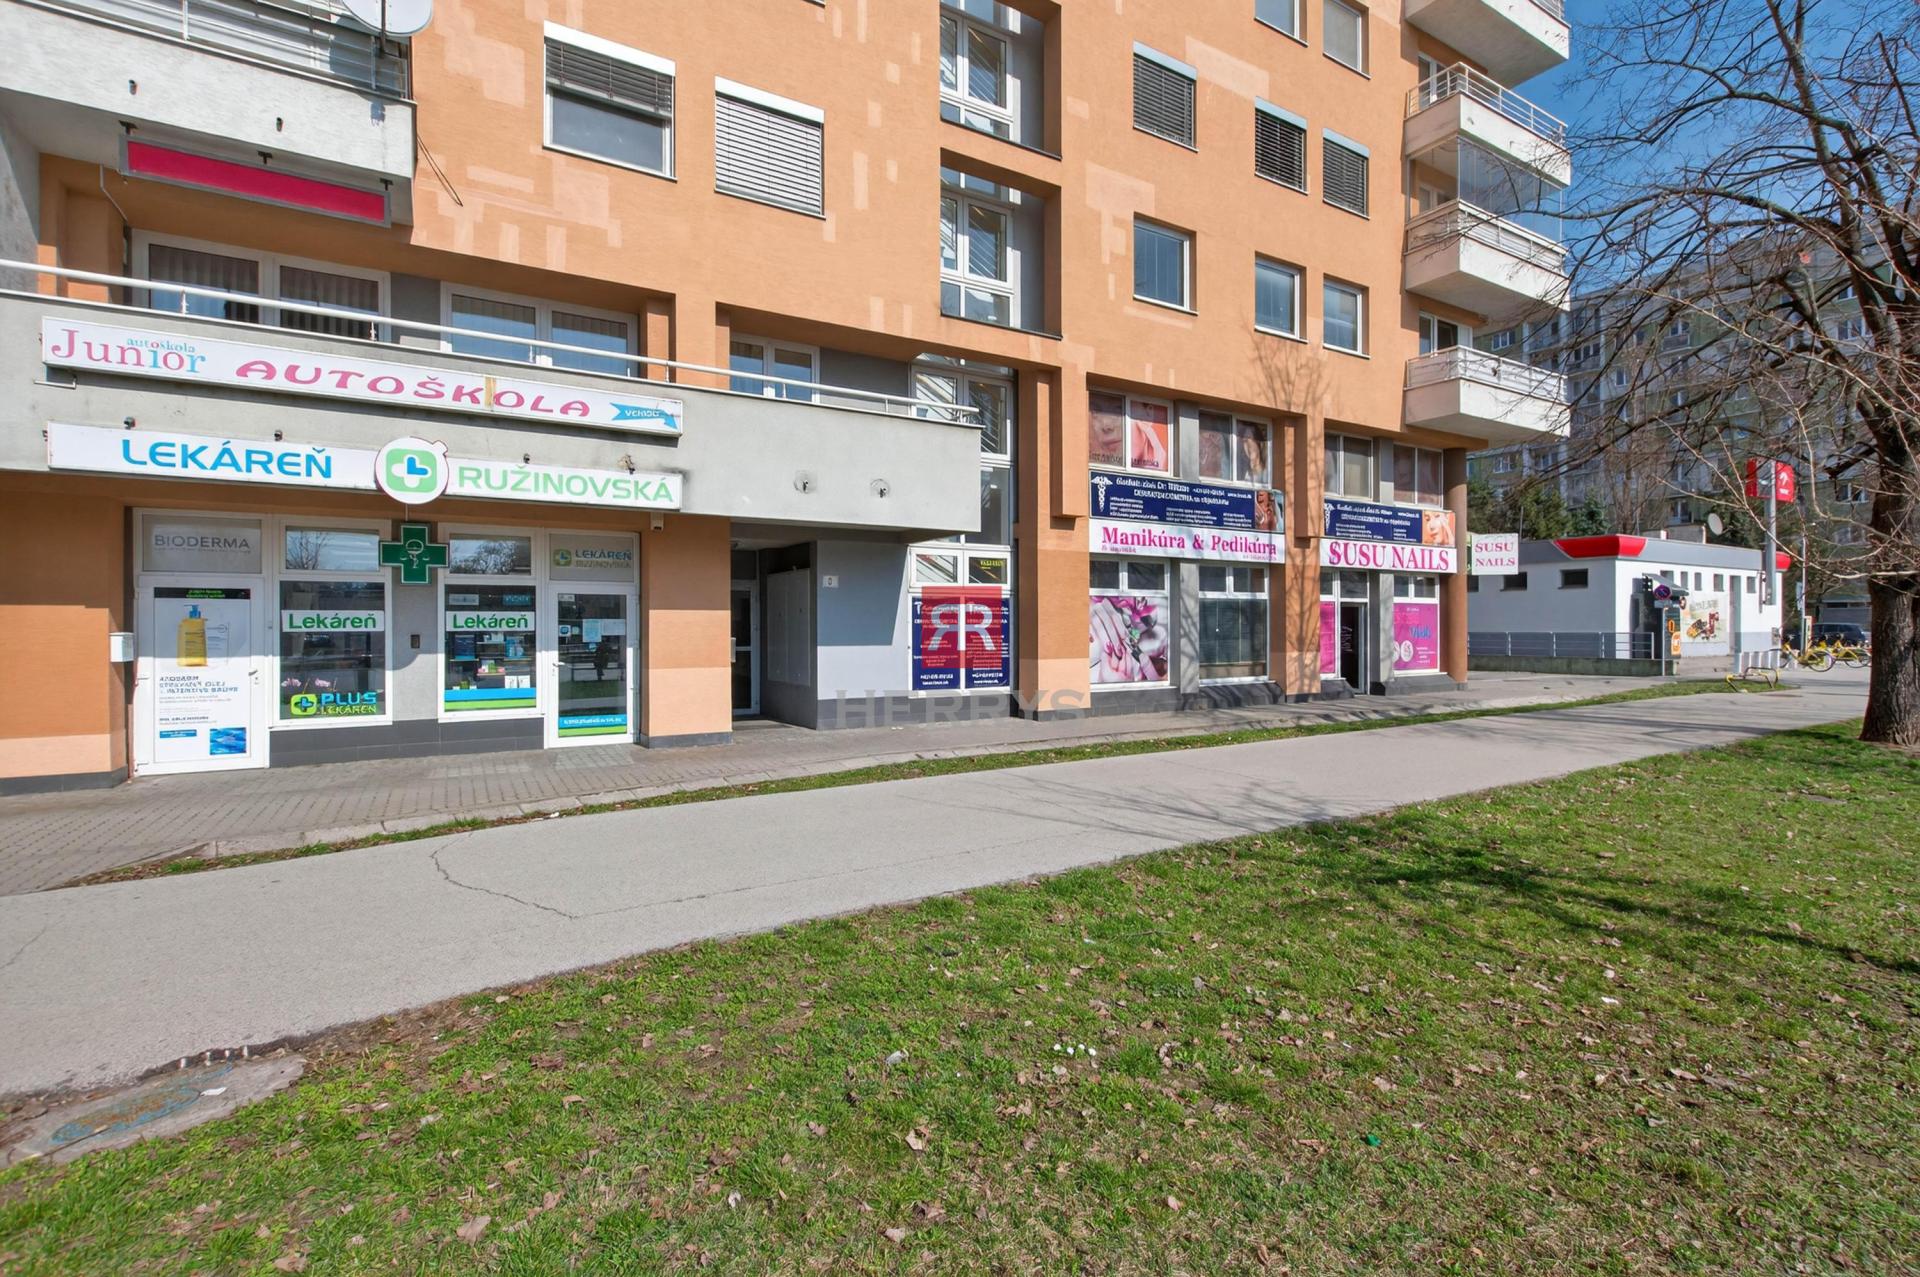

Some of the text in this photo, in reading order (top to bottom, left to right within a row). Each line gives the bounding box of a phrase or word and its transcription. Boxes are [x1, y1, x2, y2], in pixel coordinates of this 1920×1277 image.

[51, 328, 206, 373] Junior
[235, 359, 591, 418] AUTOŠKOLA
[121, 438, 674, 503] LEKÁREŇ RUŽINOVSKÁ
[154, 534, 250, 550] BIODERMA
[1101, 526, 1277, 556] Manikúra & Pedikúra
[1475, 541, 1514, 552] SUSU
[1328, 541, 1449, 571] SUSU NAILS
[1475, 557, 1516, 567] NAILS
[288, 613, 377, 629] Lekáreň
[453, 614, 528, 629] Lekáreň
[321, 692, 377, 706] PLUS
